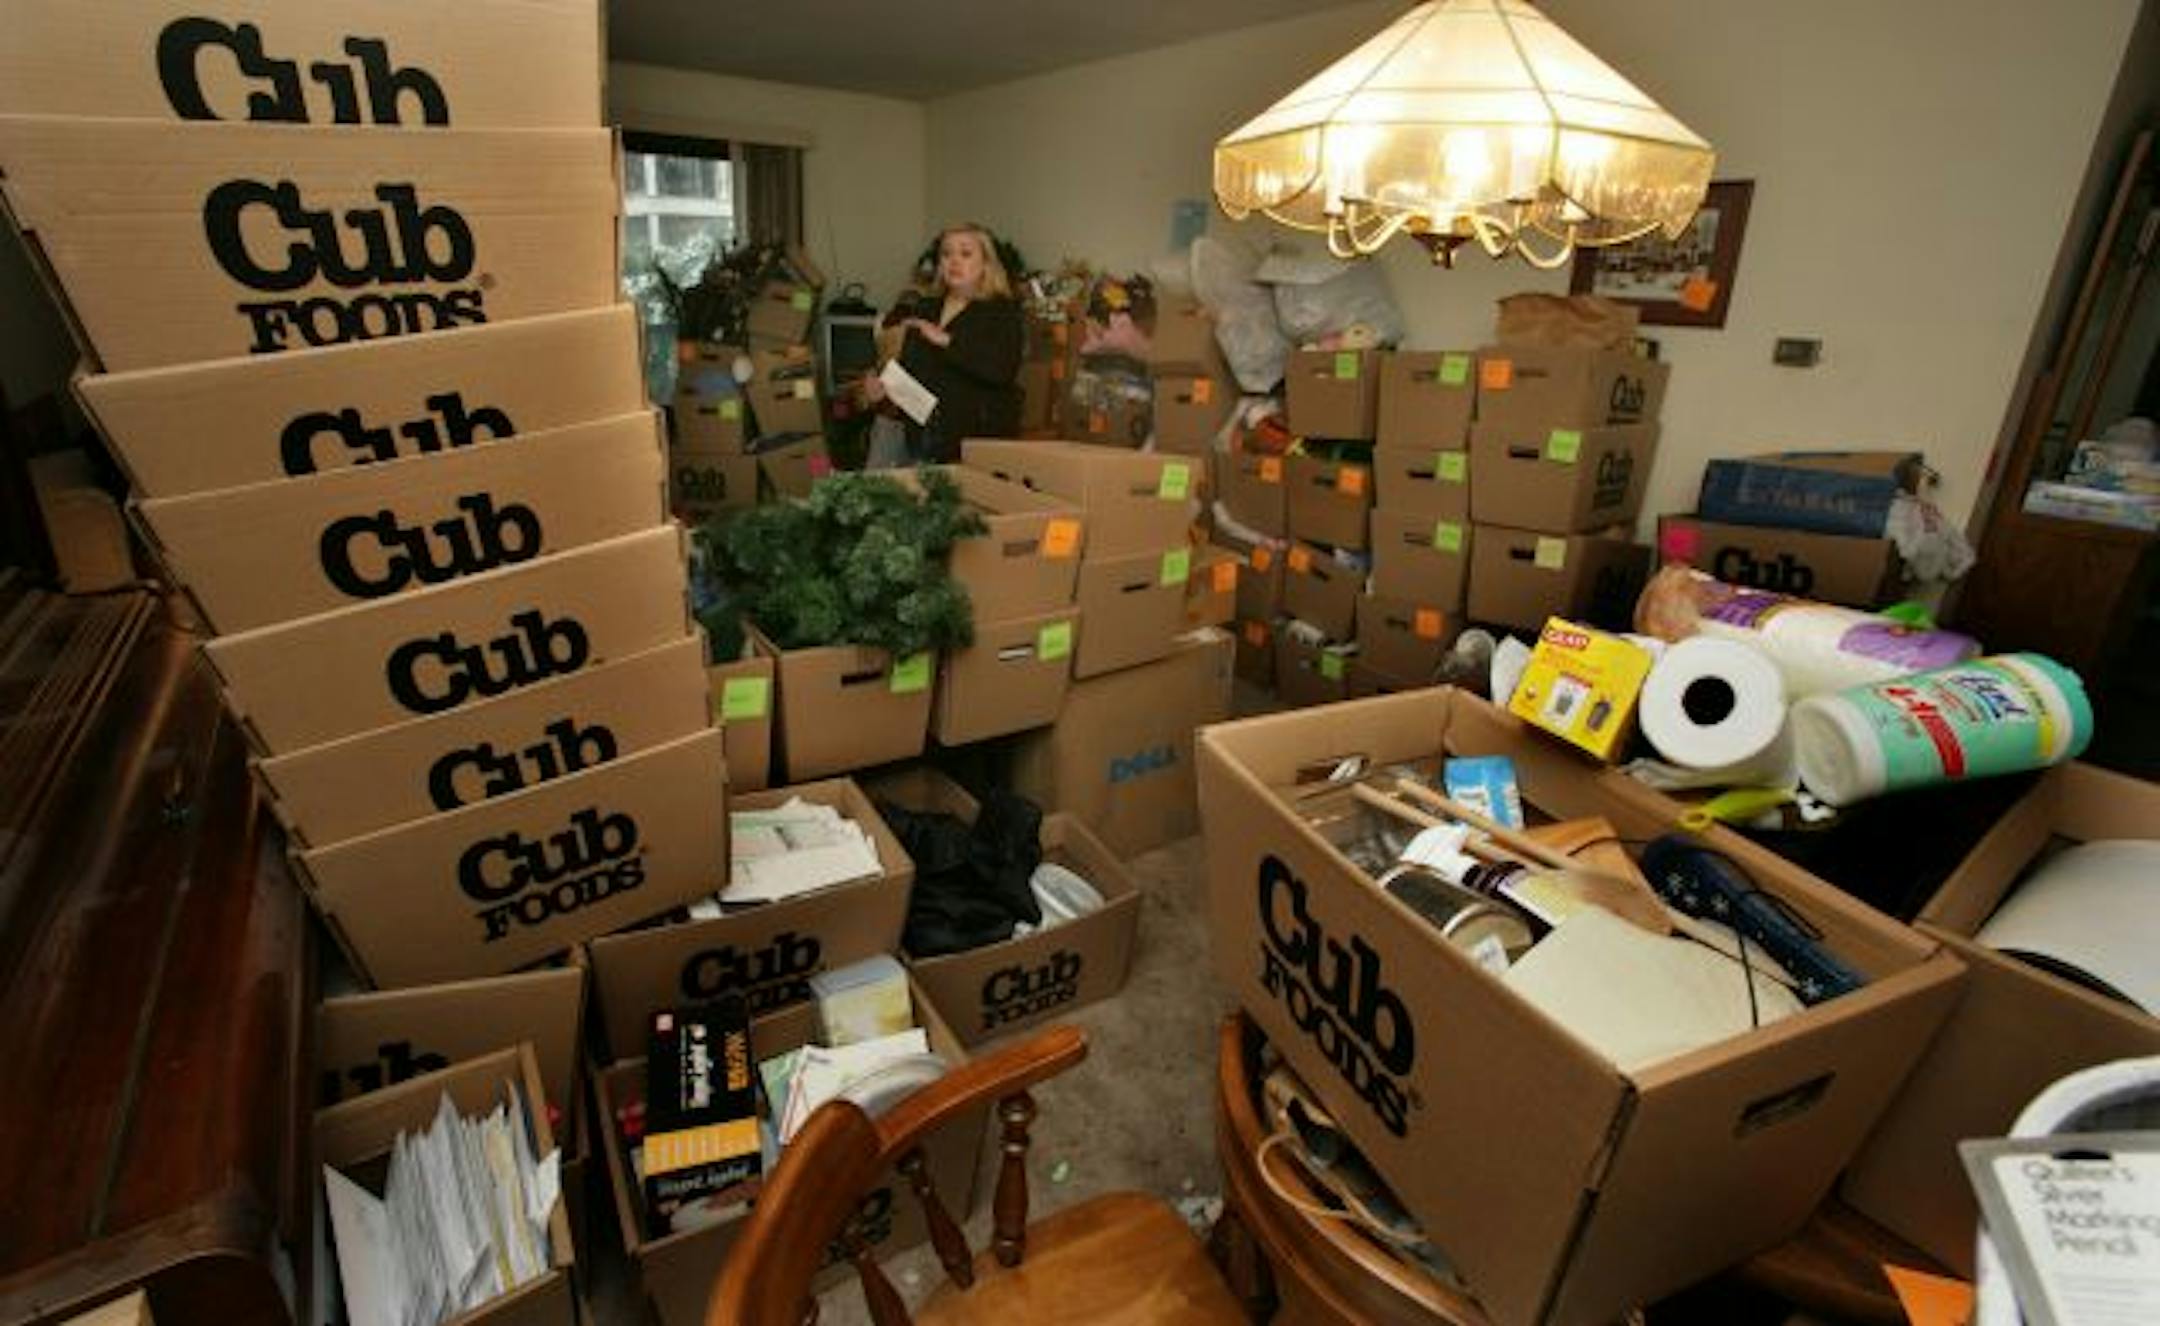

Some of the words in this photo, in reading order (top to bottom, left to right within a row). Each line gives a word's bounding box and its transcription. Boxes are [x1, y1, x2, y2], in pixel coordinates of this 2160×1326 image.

[156, 17, 449, 125] Cub
[204, 179, 475, 291] Cub
[236, 288, 486, 354] FOODS
[320, 493, 542, 598] Cub
[1715, 545, 1814, 592] Cub
[386, 610, 590, 714] Cub
[428, 719, 618, 811] Cub
[458, 809, 638, 901] Cub
[476, 857, 645, 943] FOODS
[682, 932, 821, 999] Cub
[983, 949, 1081, 1006] Cub
[1259, 855, 1415, 1076] Cub
[1260, 940, 1408, 1137] FOODS
